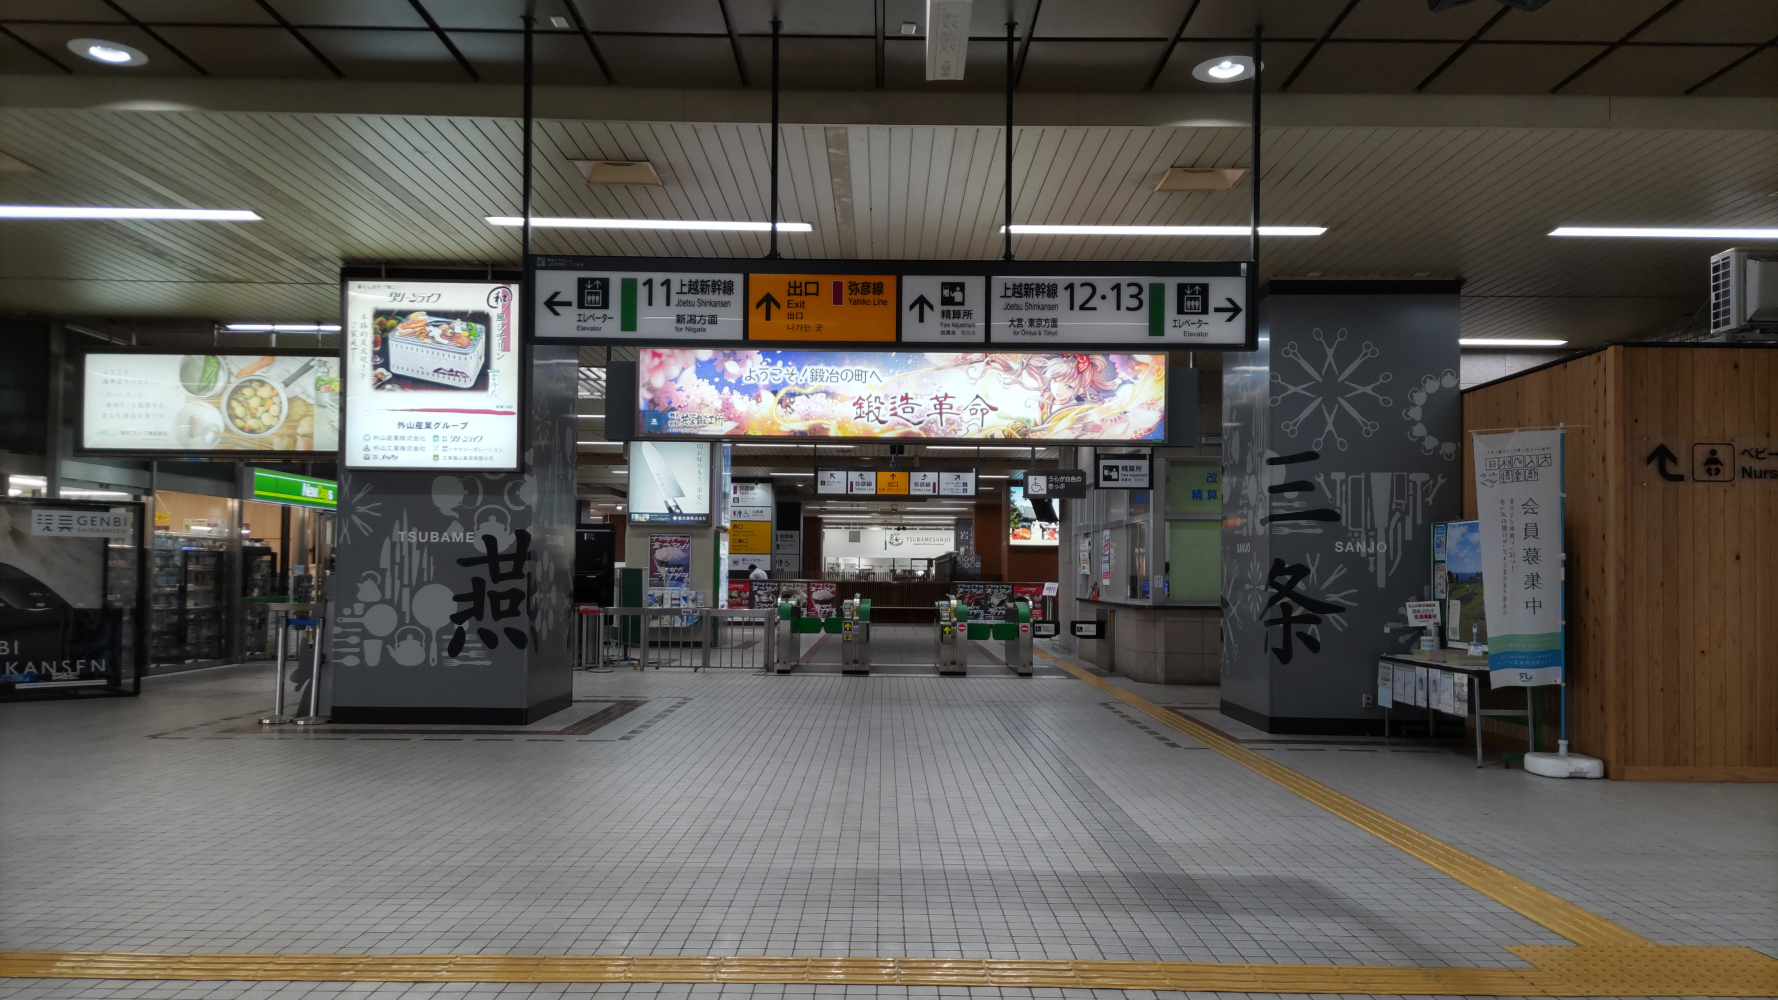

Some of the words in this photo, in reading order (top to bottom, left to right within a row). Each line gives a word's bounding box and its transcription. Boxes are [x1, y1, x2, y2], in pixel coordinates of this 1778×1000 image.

[642, 278, 671, 307] 11
[676, 279, 734, 296] 上越新幹線
[787, 280, 819, 297] 出口
[848, 281, 884, 296] 弥彦線
[1000, 282, 1059, 299] 上越新幹線
[388, 291, 442, 303] グリーンライフ
[848, 297, 872, 306] Yahiko
[873, 297, 888, 306] Line
[697, 298, 731, 308] Shinkansen
[787, 299, 806, 309] Exit
[1024, 301, 1059, 311] Shinkansen
[577, 313, 614, 323] エレベーター
[676, 314, 718, 325] 新潟方面
[787, 311, 804, 320] 出口
[940, 309, 973, 320] 精算所
[951, 321, 976, 329] Adjustment
[1172, 318, 1209, 329] エレベーター
[685, 326, 707, 334] Niigata
[852, 391, 999, 428] 鍛造革命
[397, 421, 469, 430] 外山産業グループ
[1121, 464, 1143, 472] 精算所
[1741, 465, 1778, 479] Nurs
[1048, 475, 1083, 483] うらが白色の
[301, 482, 334, 500] NewDays
[77, 515, 127, 527] GENBI
[399, 531, 475, 542] TSUBAME
[1236, 543, 1251, 553] SANJO
[1335, 541, 1387, 552] SANJO
[1259, 450, 1346, 665] 三条
[448, 528, 536, 657] 燕
